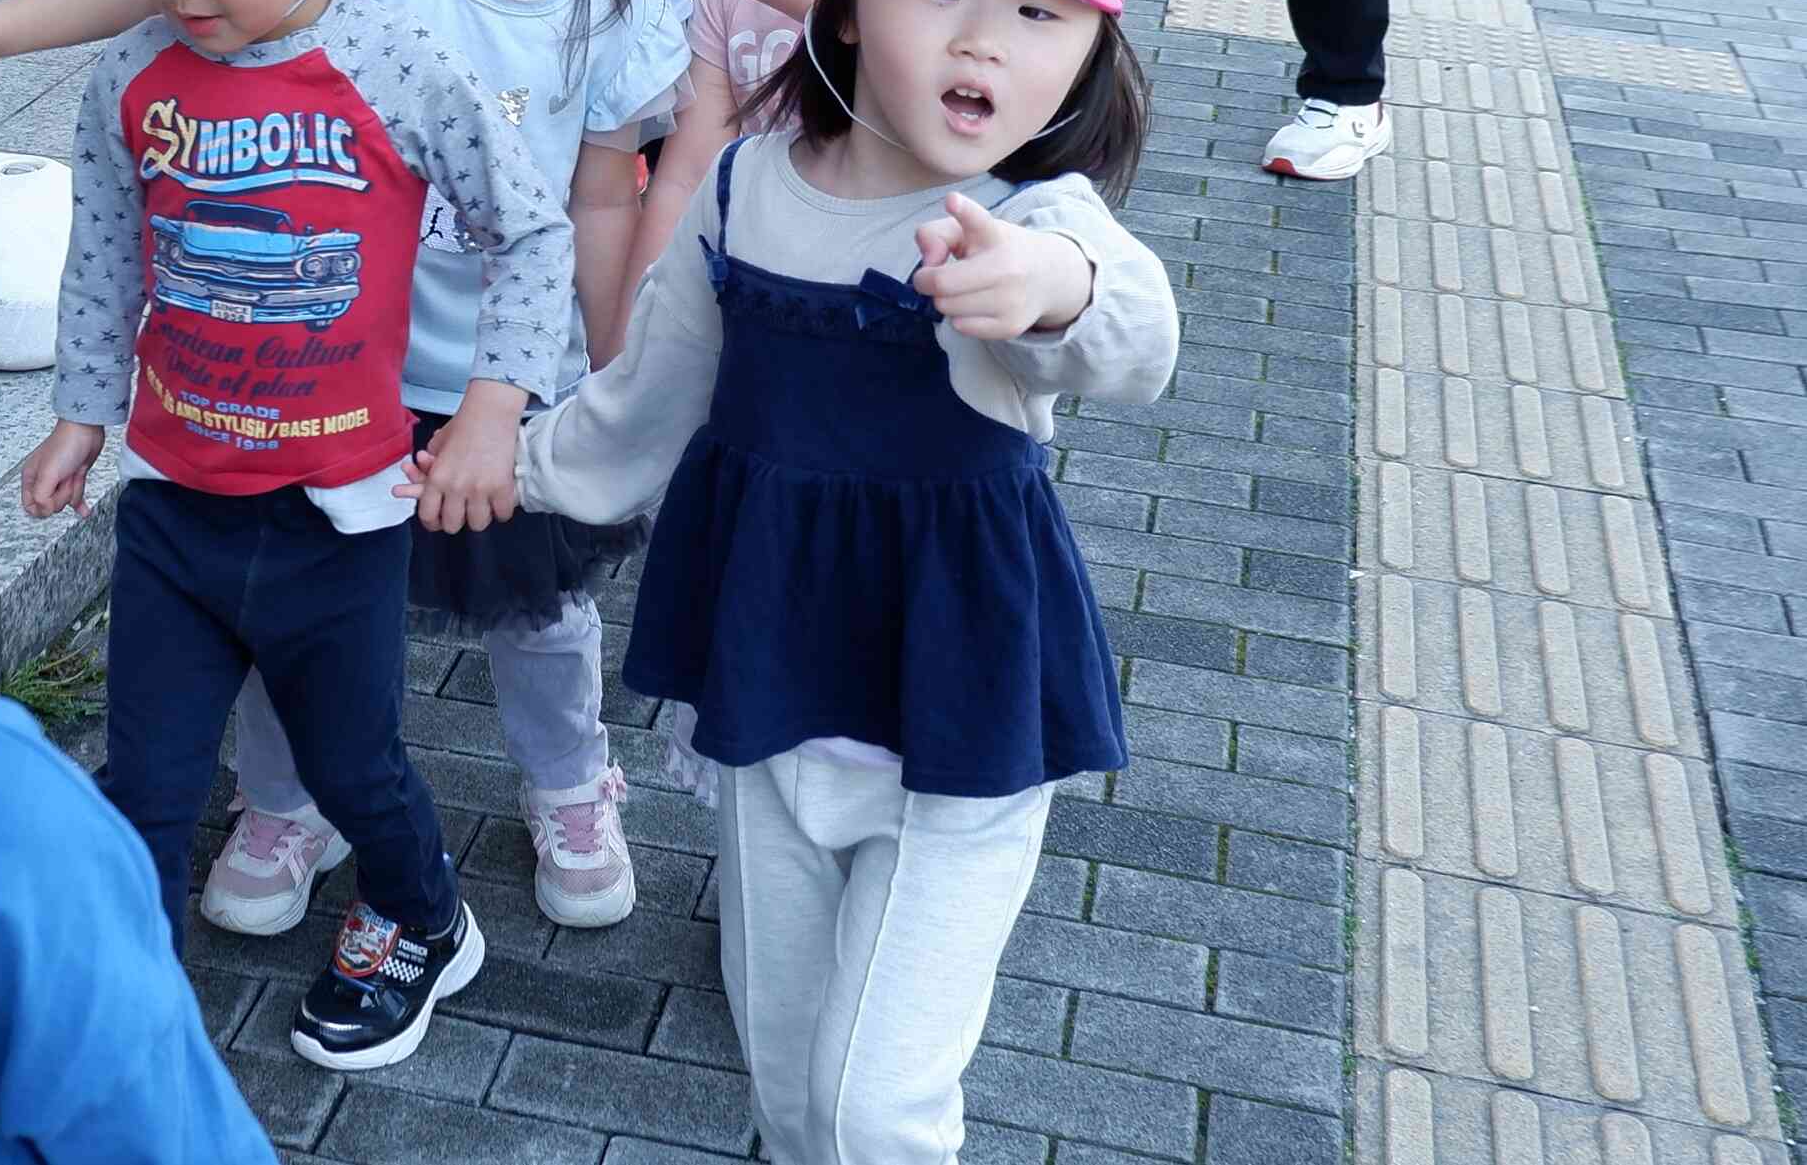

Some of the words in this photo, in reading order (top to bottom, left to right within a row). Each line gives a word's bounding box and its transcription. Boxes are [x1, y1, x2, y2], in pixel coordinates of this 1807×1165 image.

[141, 98, 358, 181] SYMBOLIC
[178, 390, 211, 407] TOP
[215, 400, 282, 421] GRADE
[324, 407, 370, 435] MODEL
